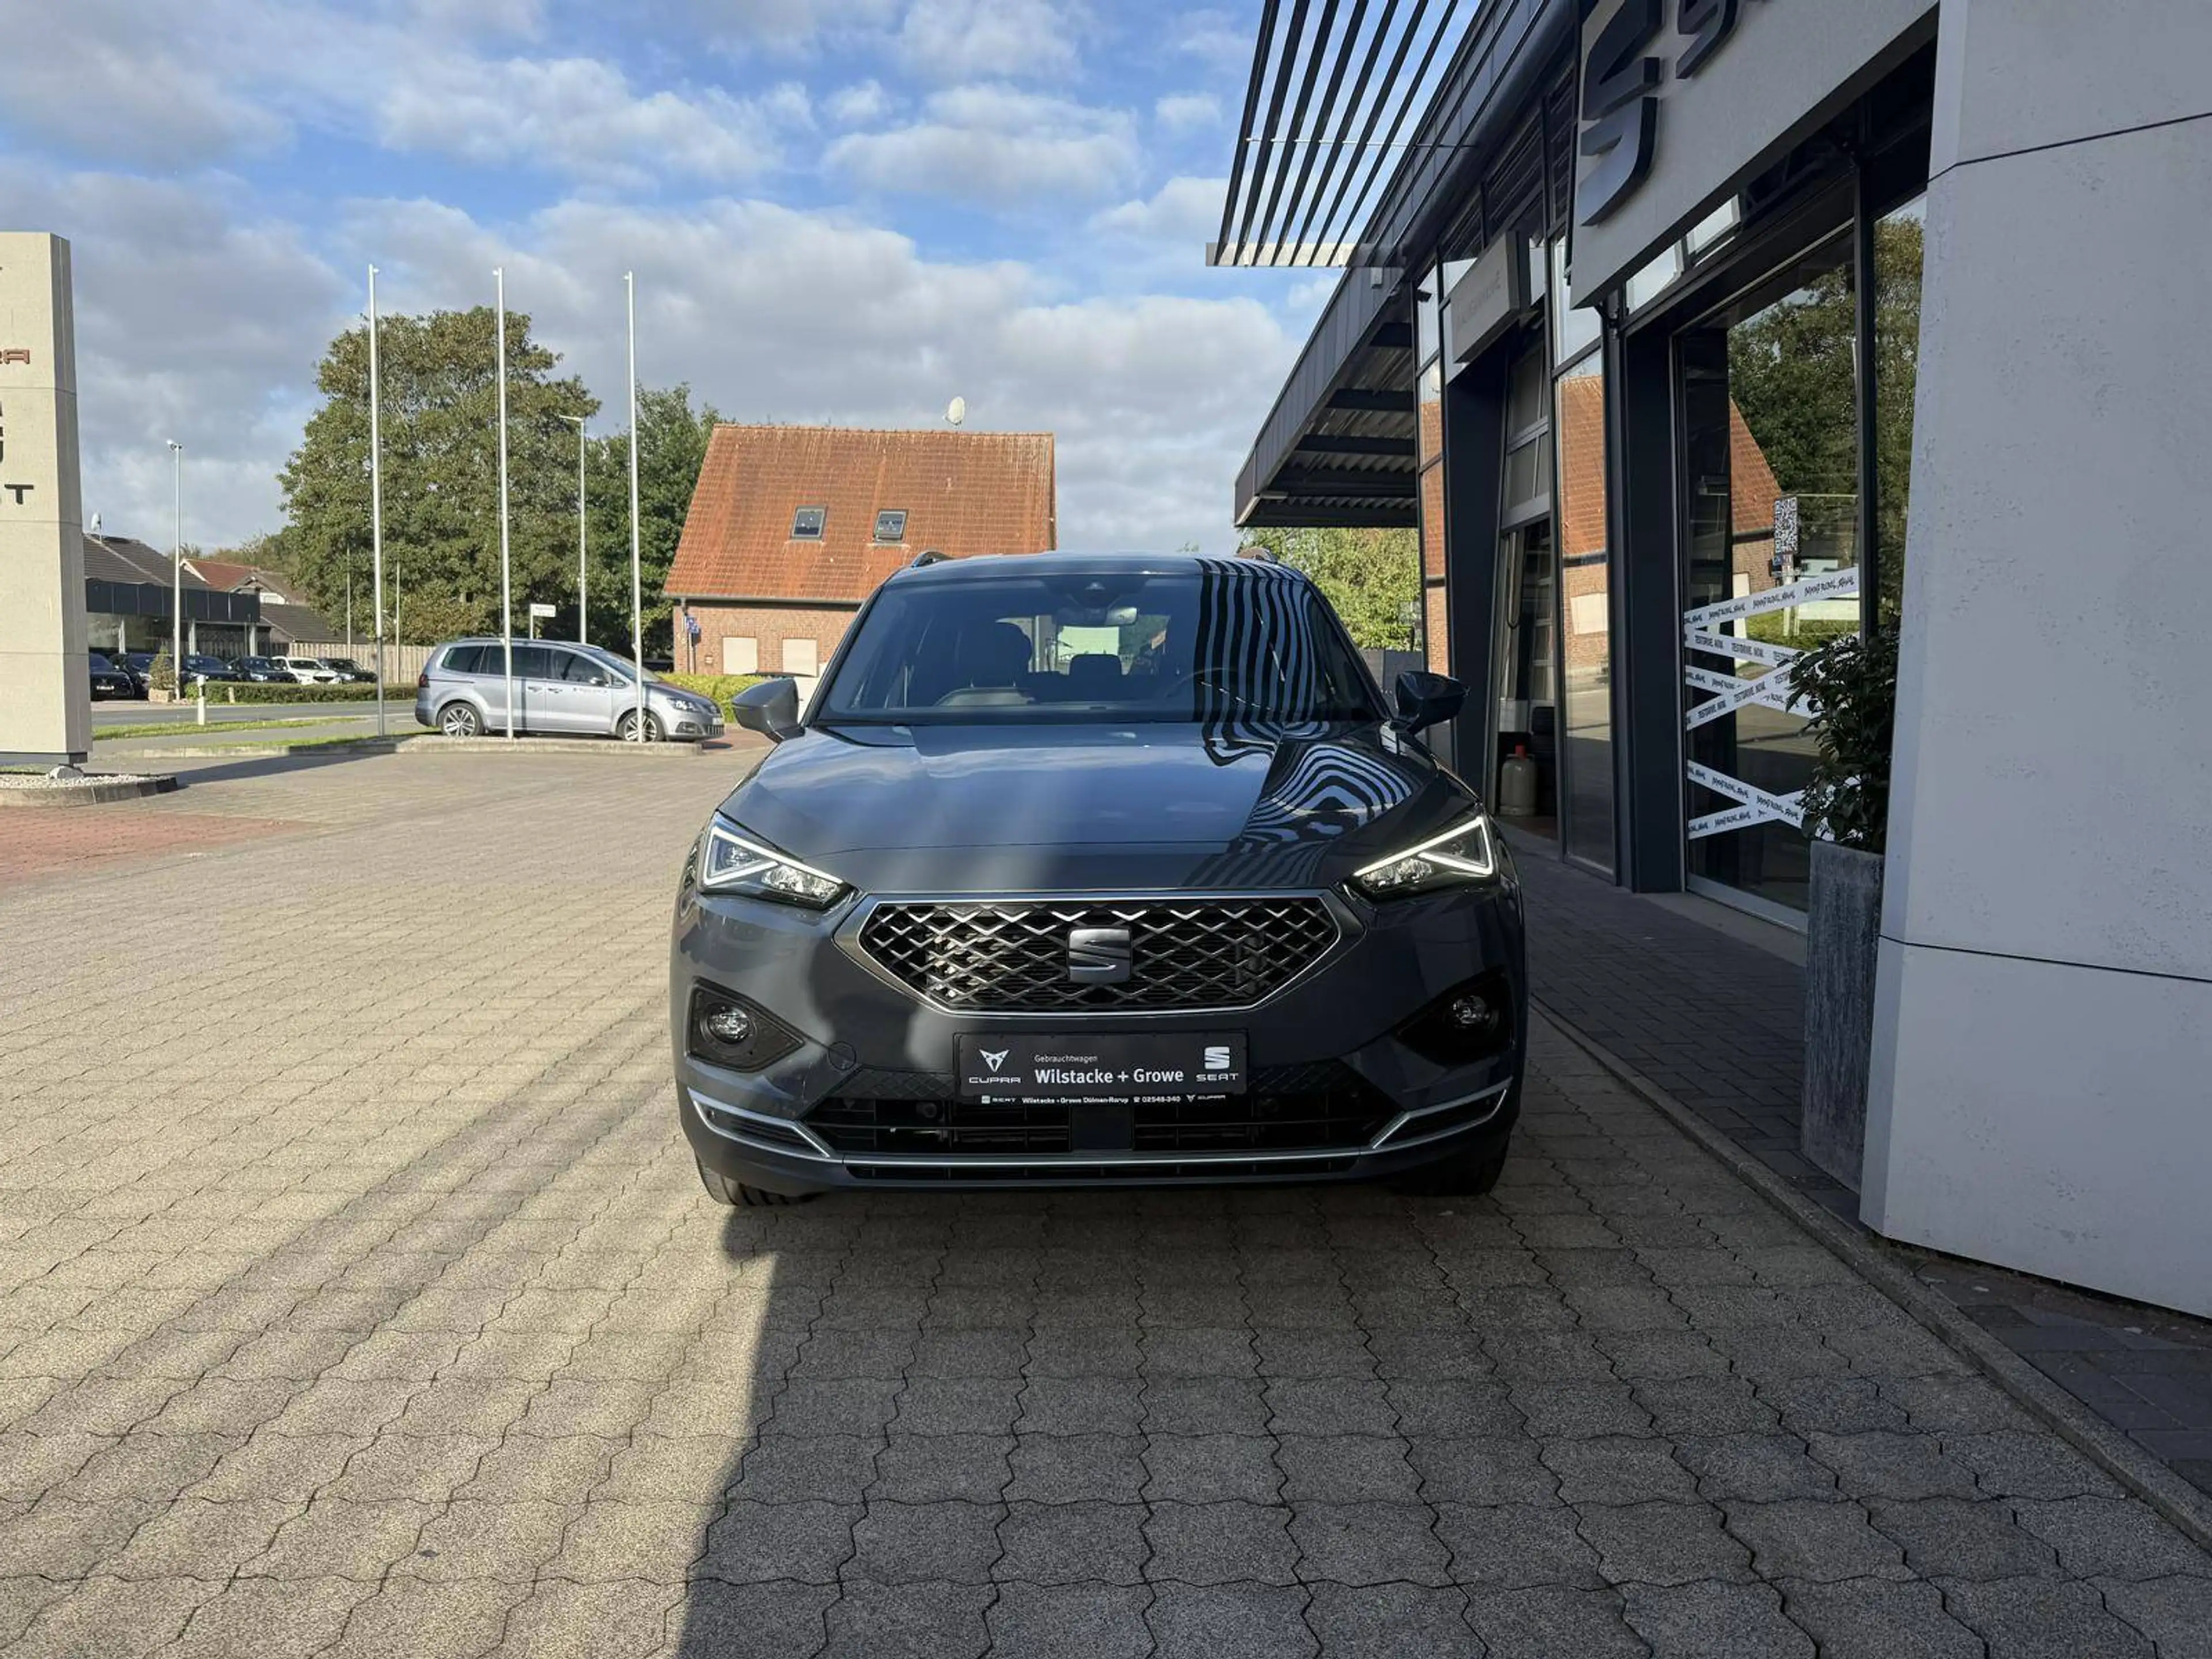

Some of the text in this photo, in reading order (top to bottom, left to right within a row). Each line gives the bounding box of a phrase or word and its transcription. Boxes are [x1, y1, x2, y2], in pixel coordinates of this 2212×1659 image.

[1034, 1054, 1097, 1064] Gebrauchtwagen
[1035, 1068, 1184, 1084] Wilstacke + Growe
[1195, 1073, 1239, 1082] SEAT
